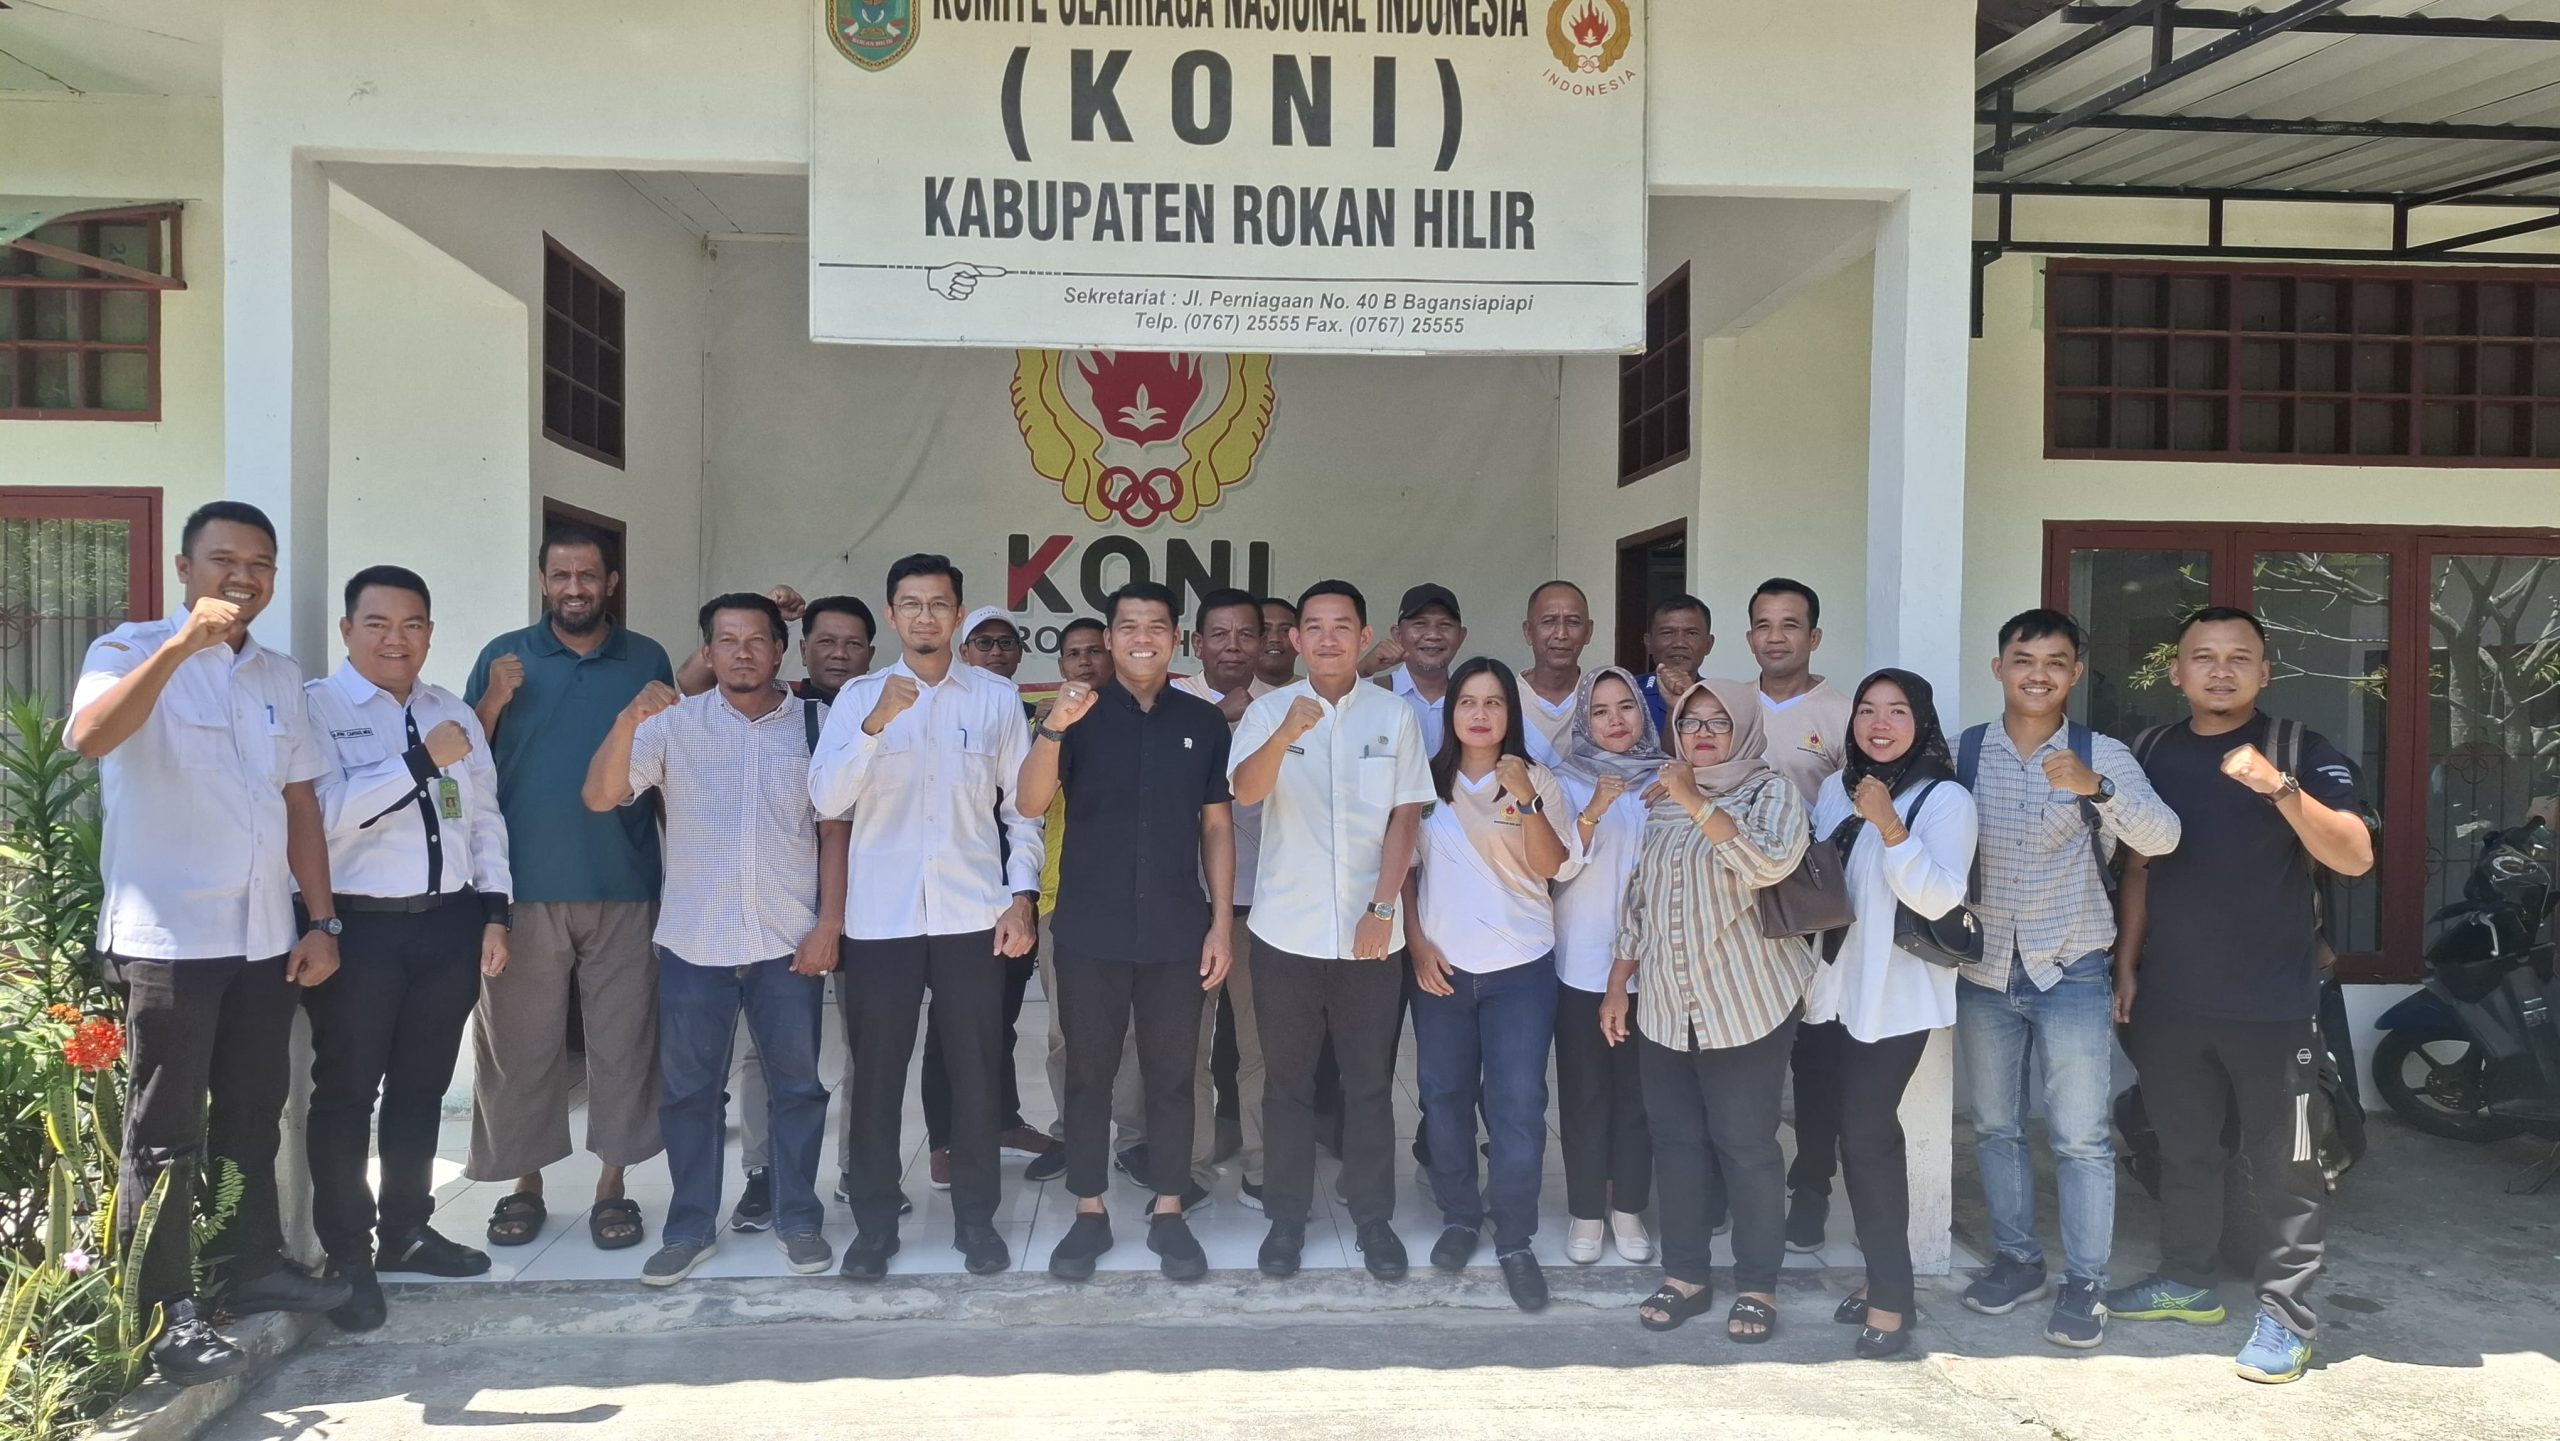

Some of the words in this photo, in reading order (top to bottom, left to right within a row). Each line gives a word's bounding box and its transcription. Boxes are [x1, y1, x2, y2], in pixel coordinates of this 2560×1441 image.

[1542, 66, 1637, 97] INDONESIA
[924, 176, 1214, 243] KABUPATEN
[1233, 184, 1396, 247] ROKAN
[1413, 188, 1536, 250] HILIR
[1063, 287, 1167, 306] Sekretariat
[1182, 289, 1203, 307] Jl.
[1209, 290, 1313, 312] Perniagaan
[1319, 293, 1350, 310] No.
[1356, 293, 1379, 310] 40
[1383, 293, 1397, 310] B
[1402, 293, 1534, 314] Bagansiapiapi
[1135, 312, 1178, 332] Telp.
[1184, 313, 1240, 335] (0767)
[1246, 315, 1300, 331] 25555
[1305, 316, 1343, 333] Fax.
[1349, 316, 1405, 337] (0767)
[1411, 317, 1464, 333] 25555
[1007, 533, 1269, 616] KONI
